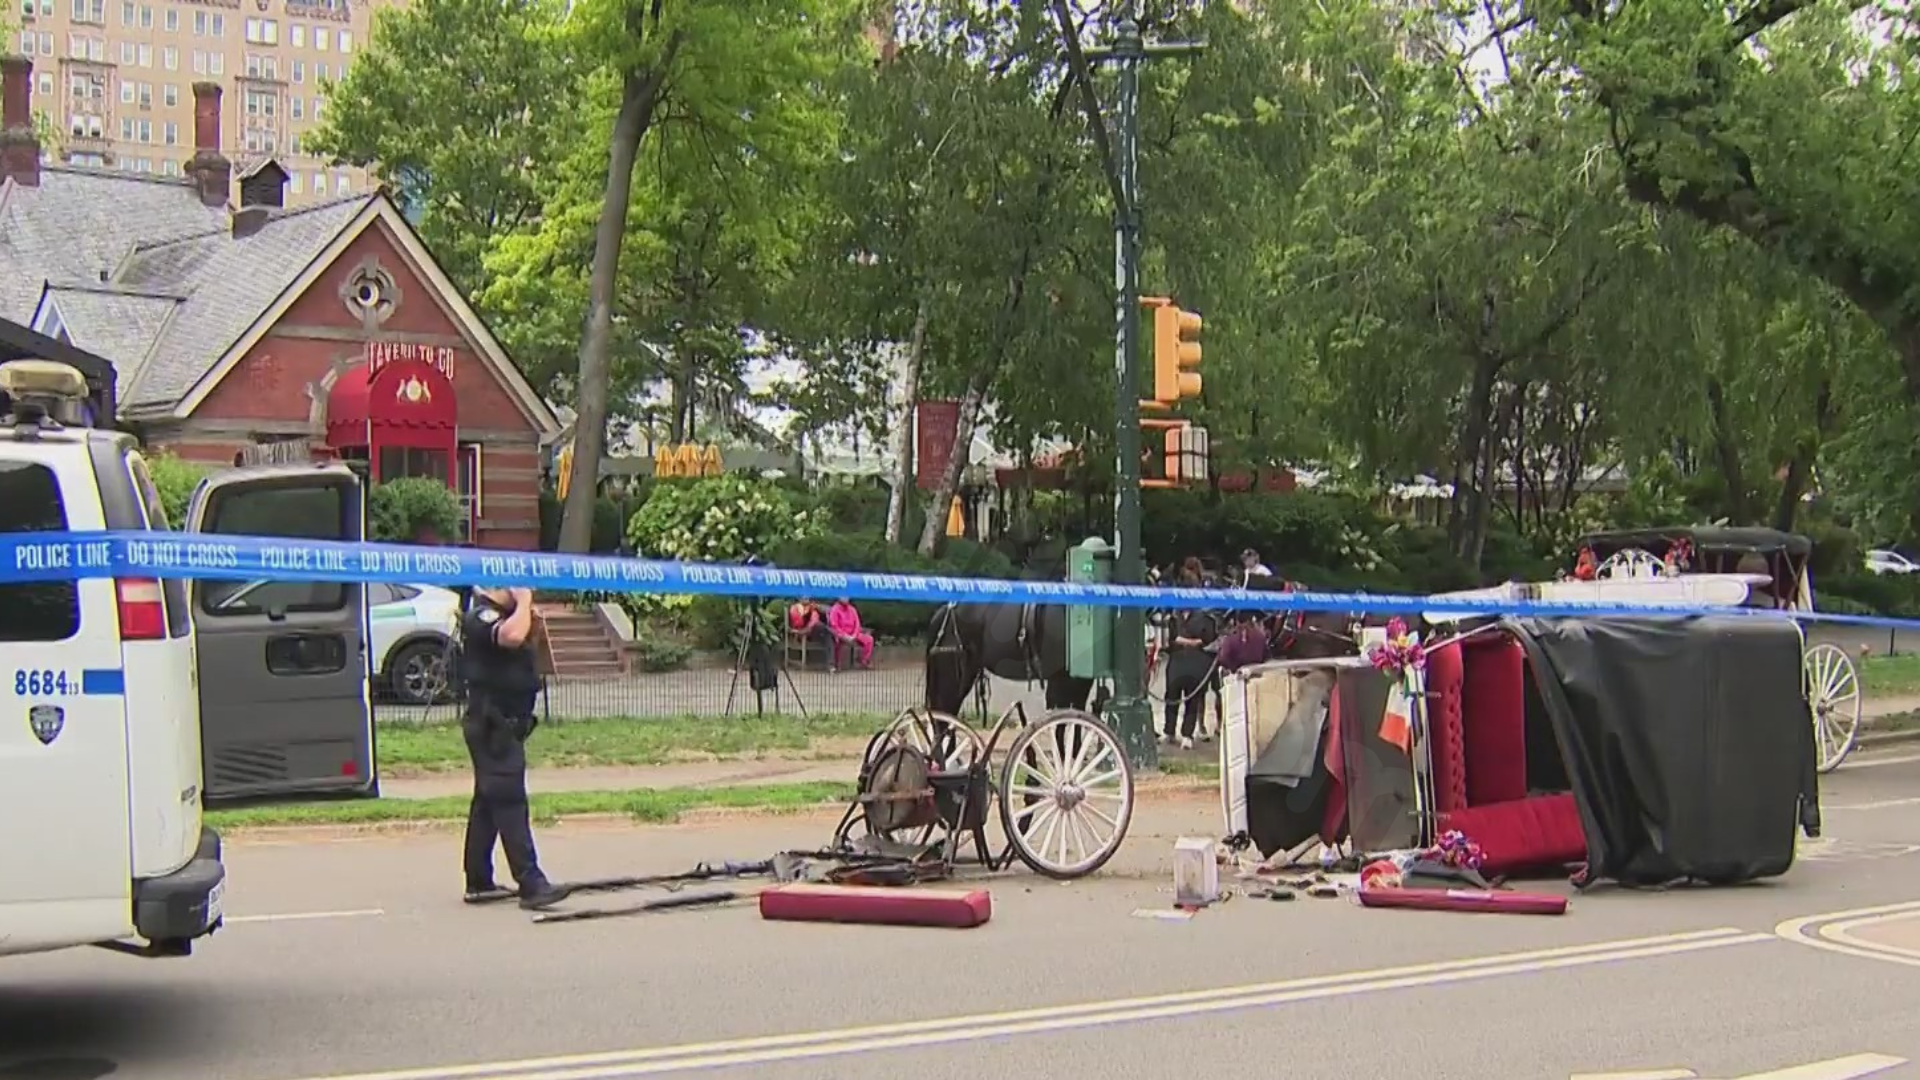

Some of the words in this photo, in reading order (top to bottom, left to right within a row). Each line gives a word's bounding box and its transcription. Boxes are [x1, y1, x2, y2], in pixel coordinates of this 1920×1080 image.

[439, 347, 454, 380] GO
[16, 544, 71, 569] POLICE
[77, 542, 112, 567] LINE
[128, 541, 148, 565] DO
[152, 542, 182, 566] NOT
[187, 544, 238, 567] CROSS
[260, 547, 311, 569] POLICE
[315, 549, 347, 571] LINE
[361, 550, 380, 572] DO
[384, 551, 409, 573] NOT
[415, 552, 461, 574] CROSS
[481, 556, 528, 577] POLICE
[532, 558, 560, 578] LINE
[573, 559, 590, 579] DO
[594, 561, 617, 580] NOT
[622, 562, 664, 582] CROSS
[681, 565, 725, 584] POLICE
[728, 567, 754, 585] LINE
[764, 568, 781, 586] DO
[784, 569, 805, 586] NOT
[808, 571, 847, 588] CROSS
[15, 669, 67, 695] 8684
